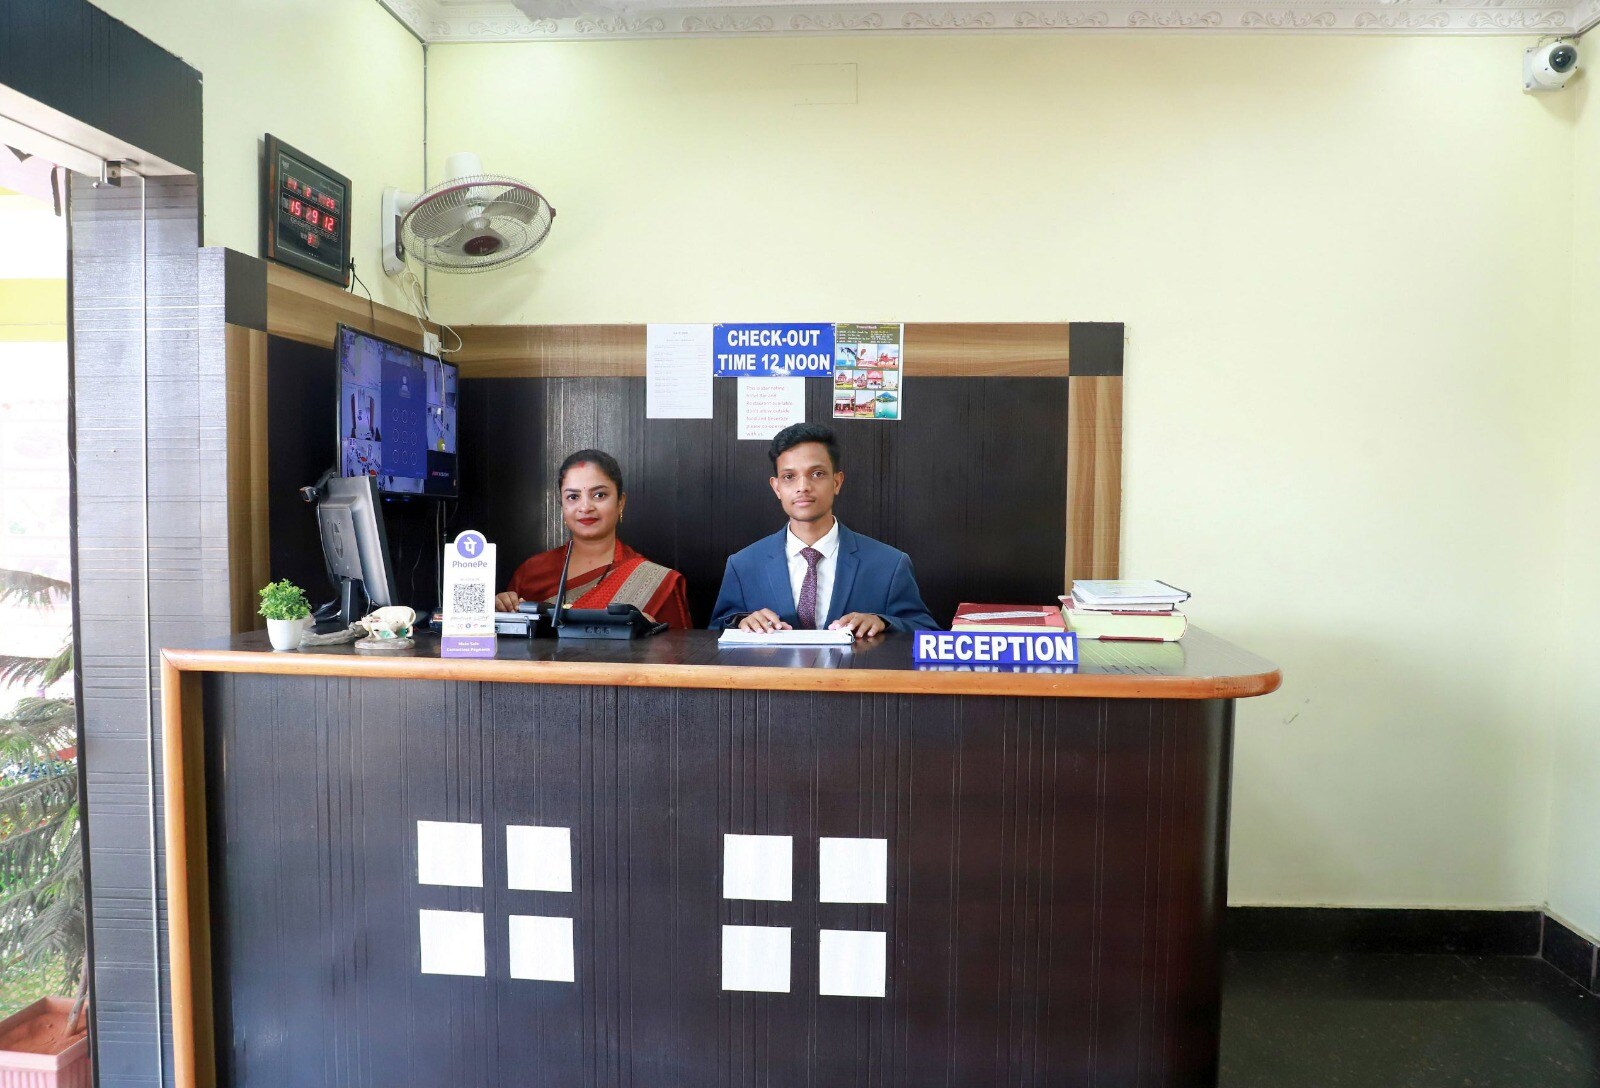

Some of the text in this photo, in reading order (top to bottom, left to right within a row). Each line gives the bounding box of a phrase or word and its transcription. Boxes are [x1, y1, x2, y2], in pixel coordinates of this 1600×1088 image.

[290, 200, 302, 216] 15
[324, 216, 335, 232] 12
[727, 329, 821, 347] CHECK-OUT
[717, 353, 831, 371] TIME 12 NOON
[452, 560, 488, 568] PhonePe
[919, 634, 1075, 662] RECEPTION
